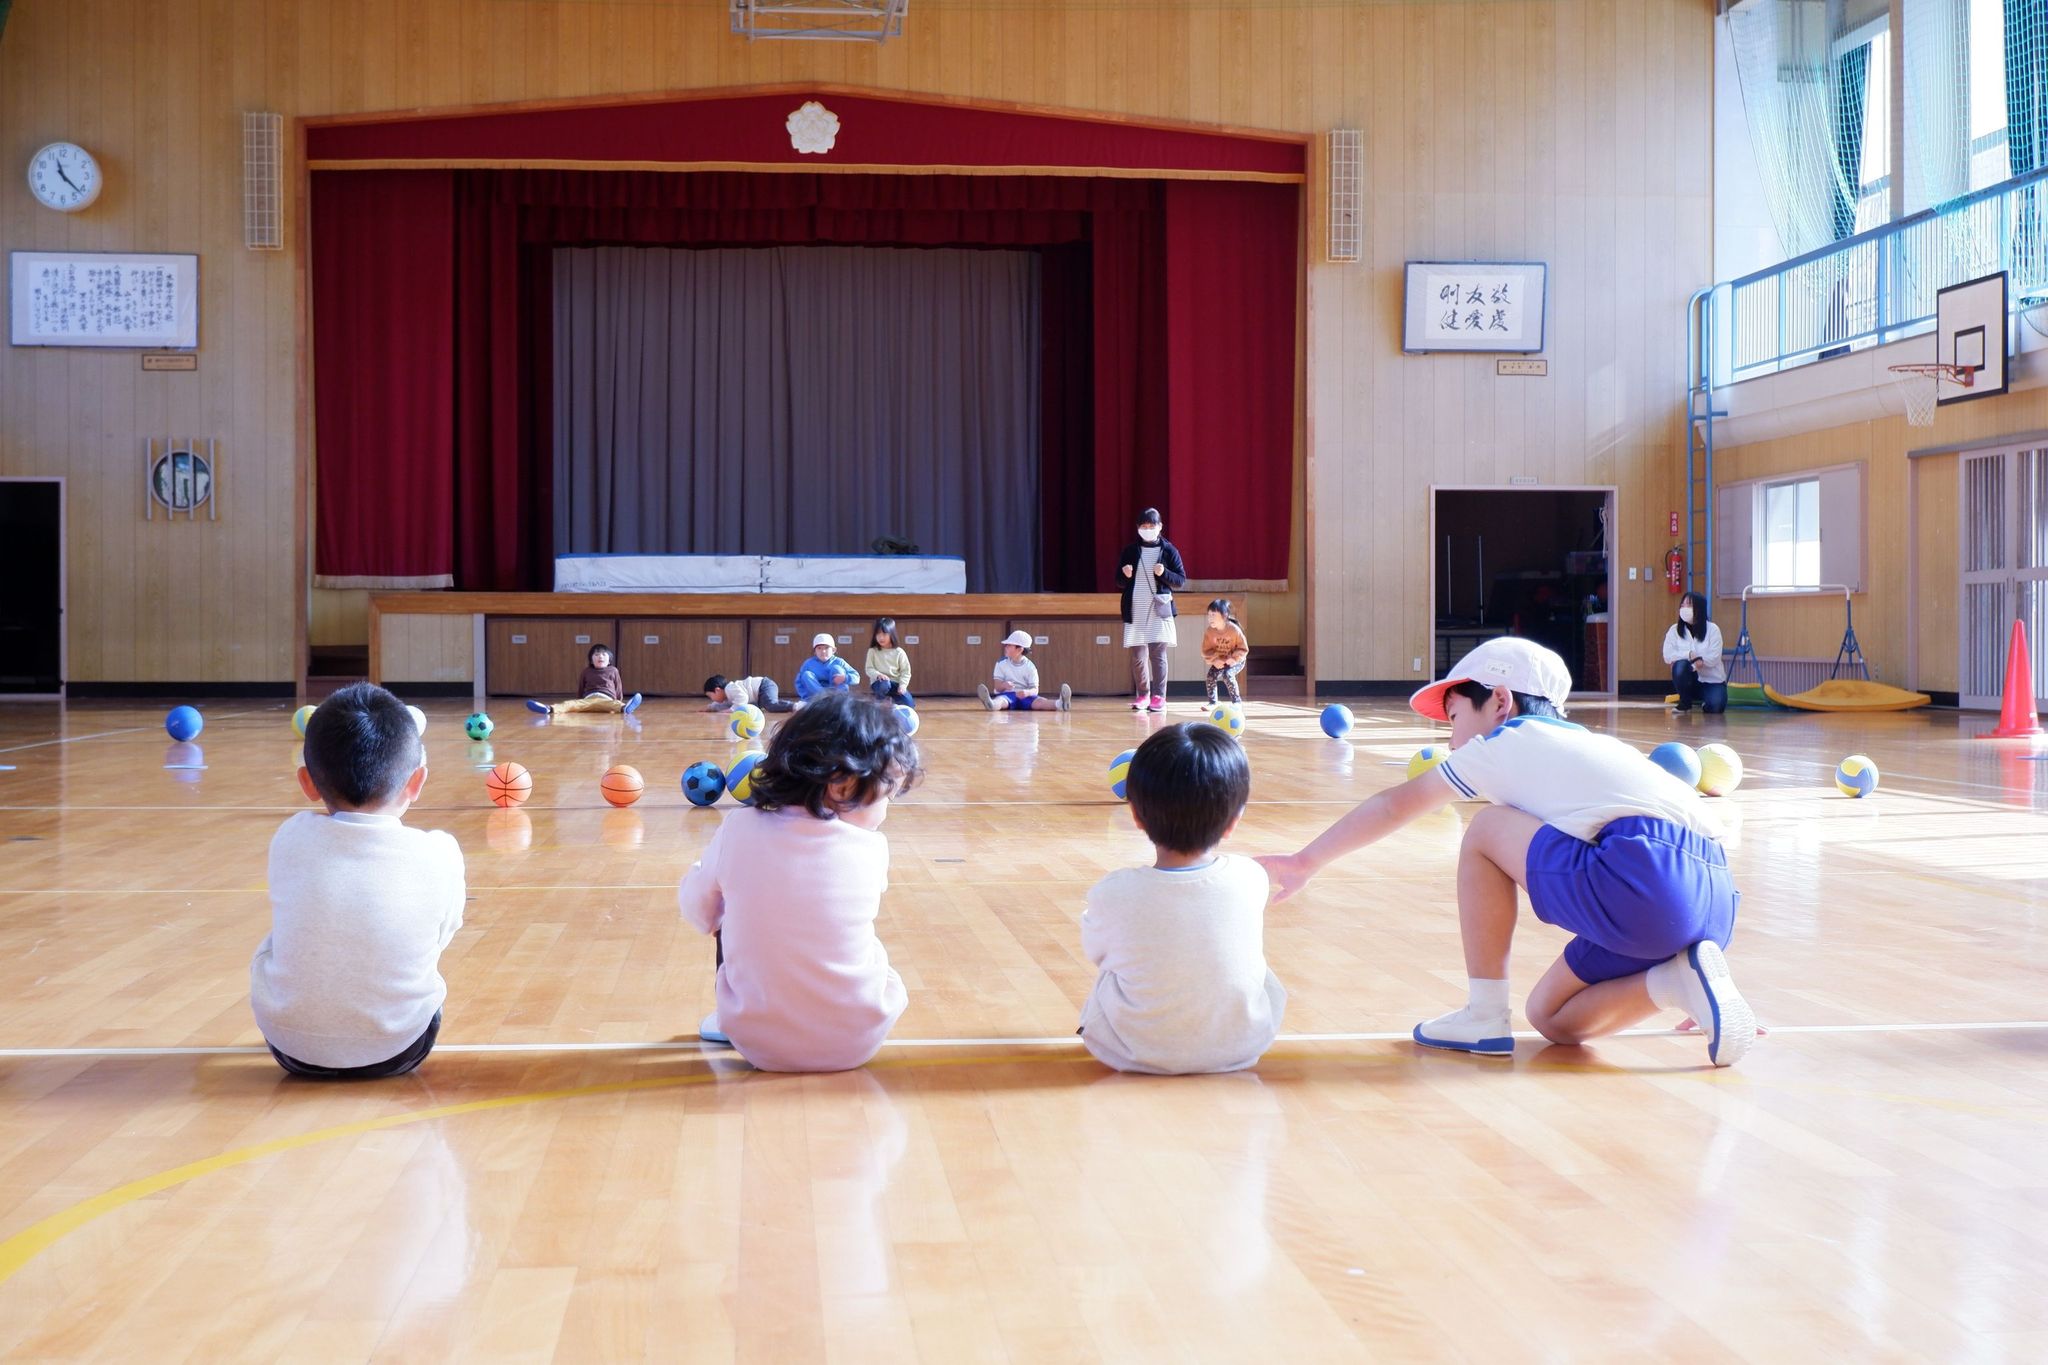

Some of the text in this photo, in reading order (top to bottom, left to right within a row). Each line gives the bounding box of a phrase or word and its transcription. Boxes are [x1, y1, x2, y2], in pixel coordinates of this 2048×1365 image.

[48, 152, 55, 160] 11
[59, 149, 67, 158] 12
[40, 160, 47, 169] 10
[81, 160, 87, 169] 2
[37, 171, 42, 180] 9
[84, 171, 89, 180] 3
[40, 183, 46, 192] 8
[80, 184, 86, 192] 4
[50, 191, 55, 199] 7
[61, 194, 66, 204] 6
[72, 191, 78, 200] 5
[1465, 283, 1485, 331] 友愛
